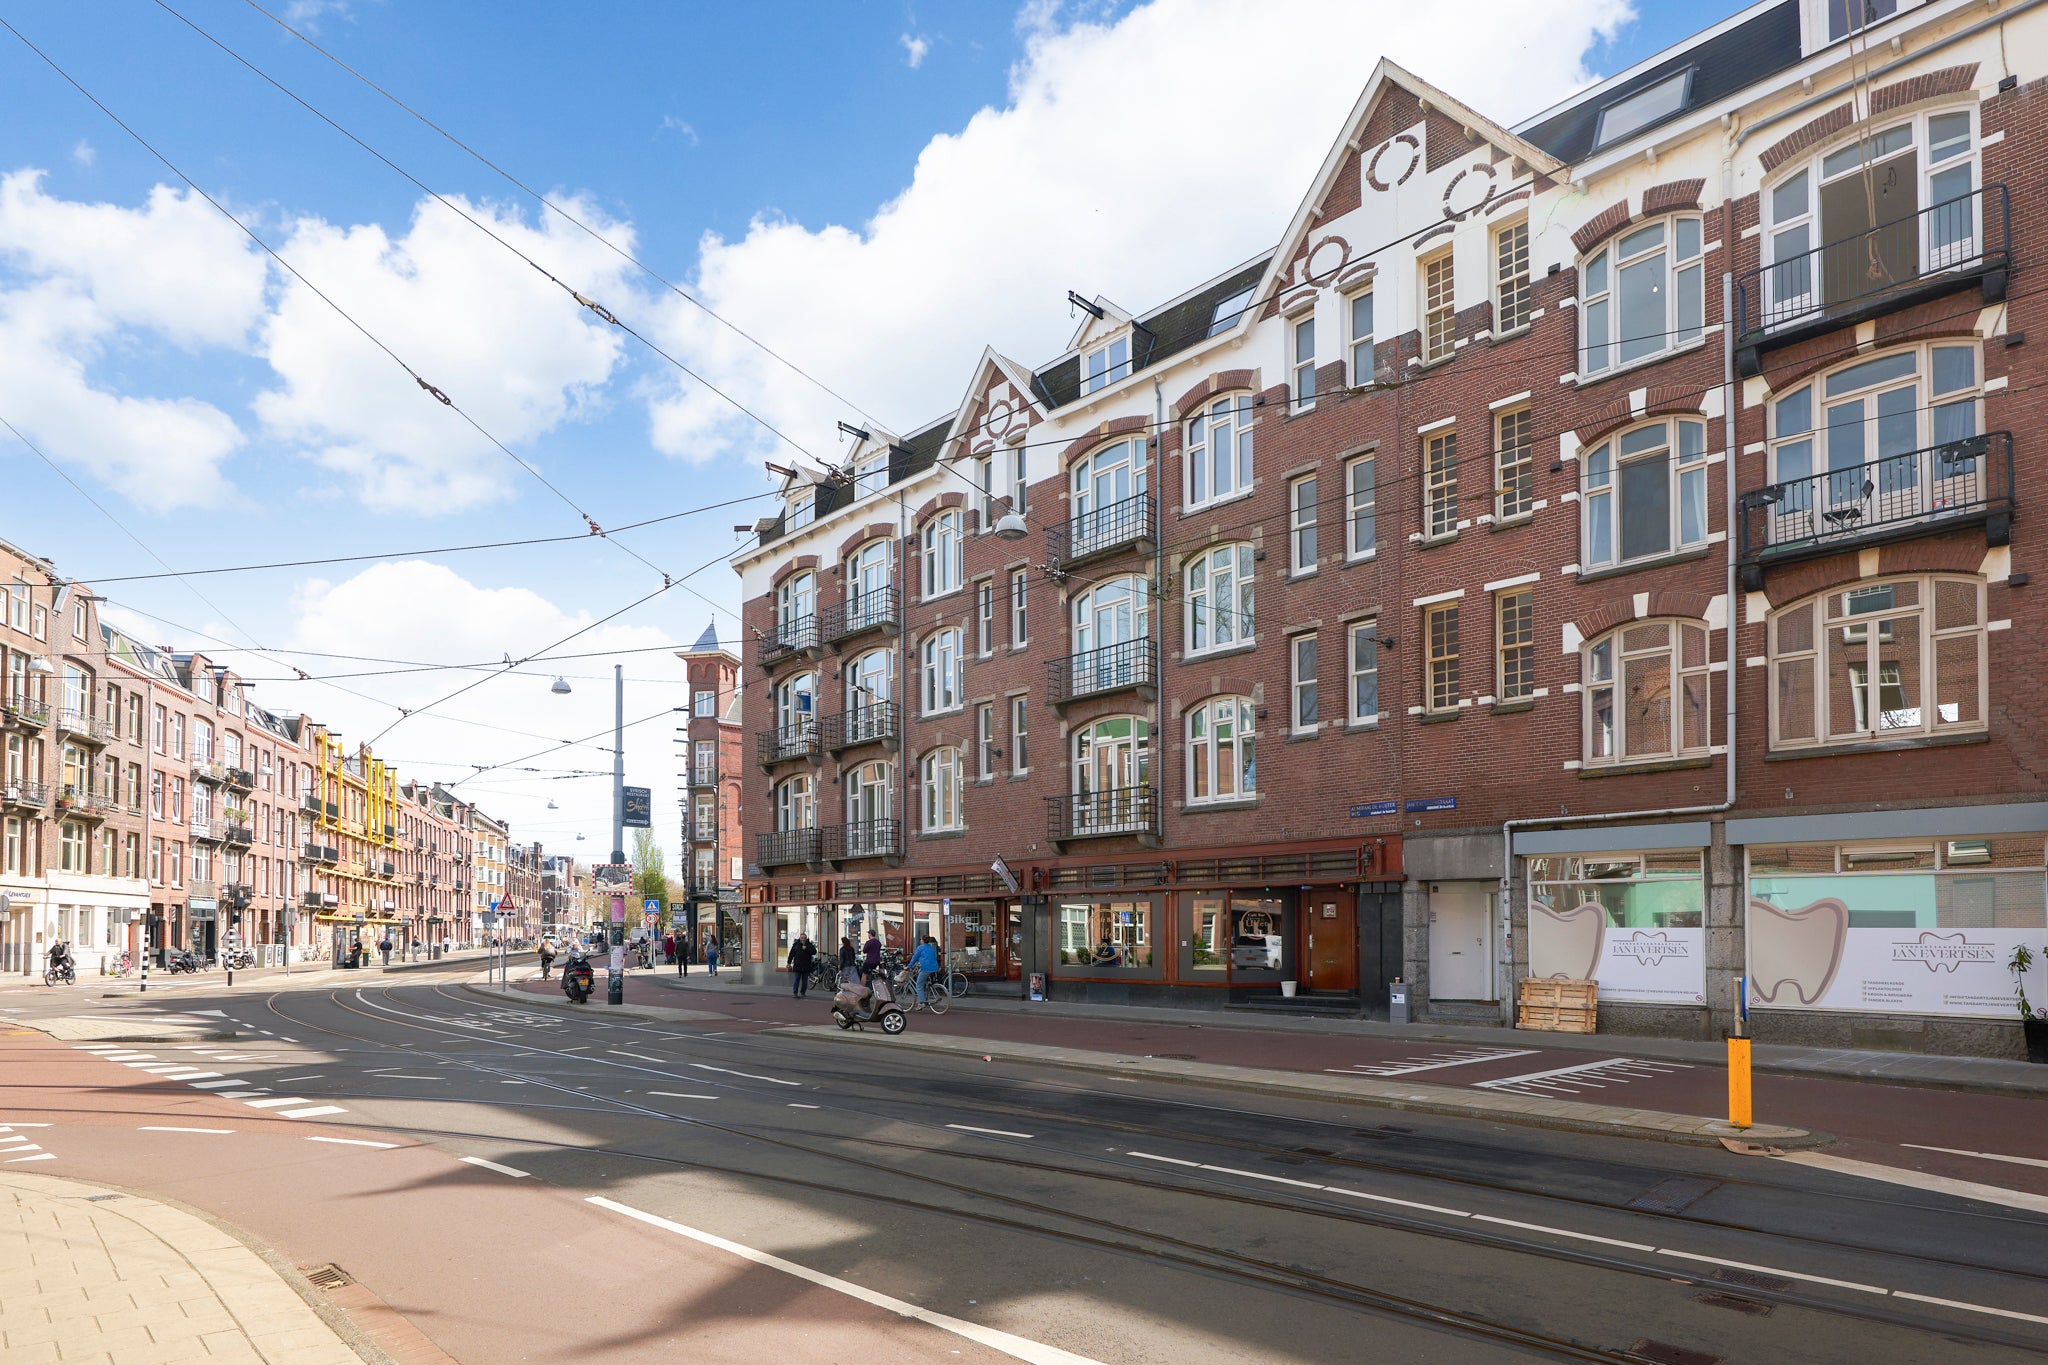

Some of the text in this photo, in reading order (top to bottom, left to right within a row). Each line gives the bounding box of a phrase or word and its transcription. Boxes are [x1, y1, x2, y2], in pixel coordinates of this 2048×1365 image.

[947, 914, 972, 924] Bike
[965, 924, 994, 934] Shop
[1613, 946, 1689, 954] JAN EVERTSEN
[1892, 949, 1995, 960] JAN EVERTSEN
